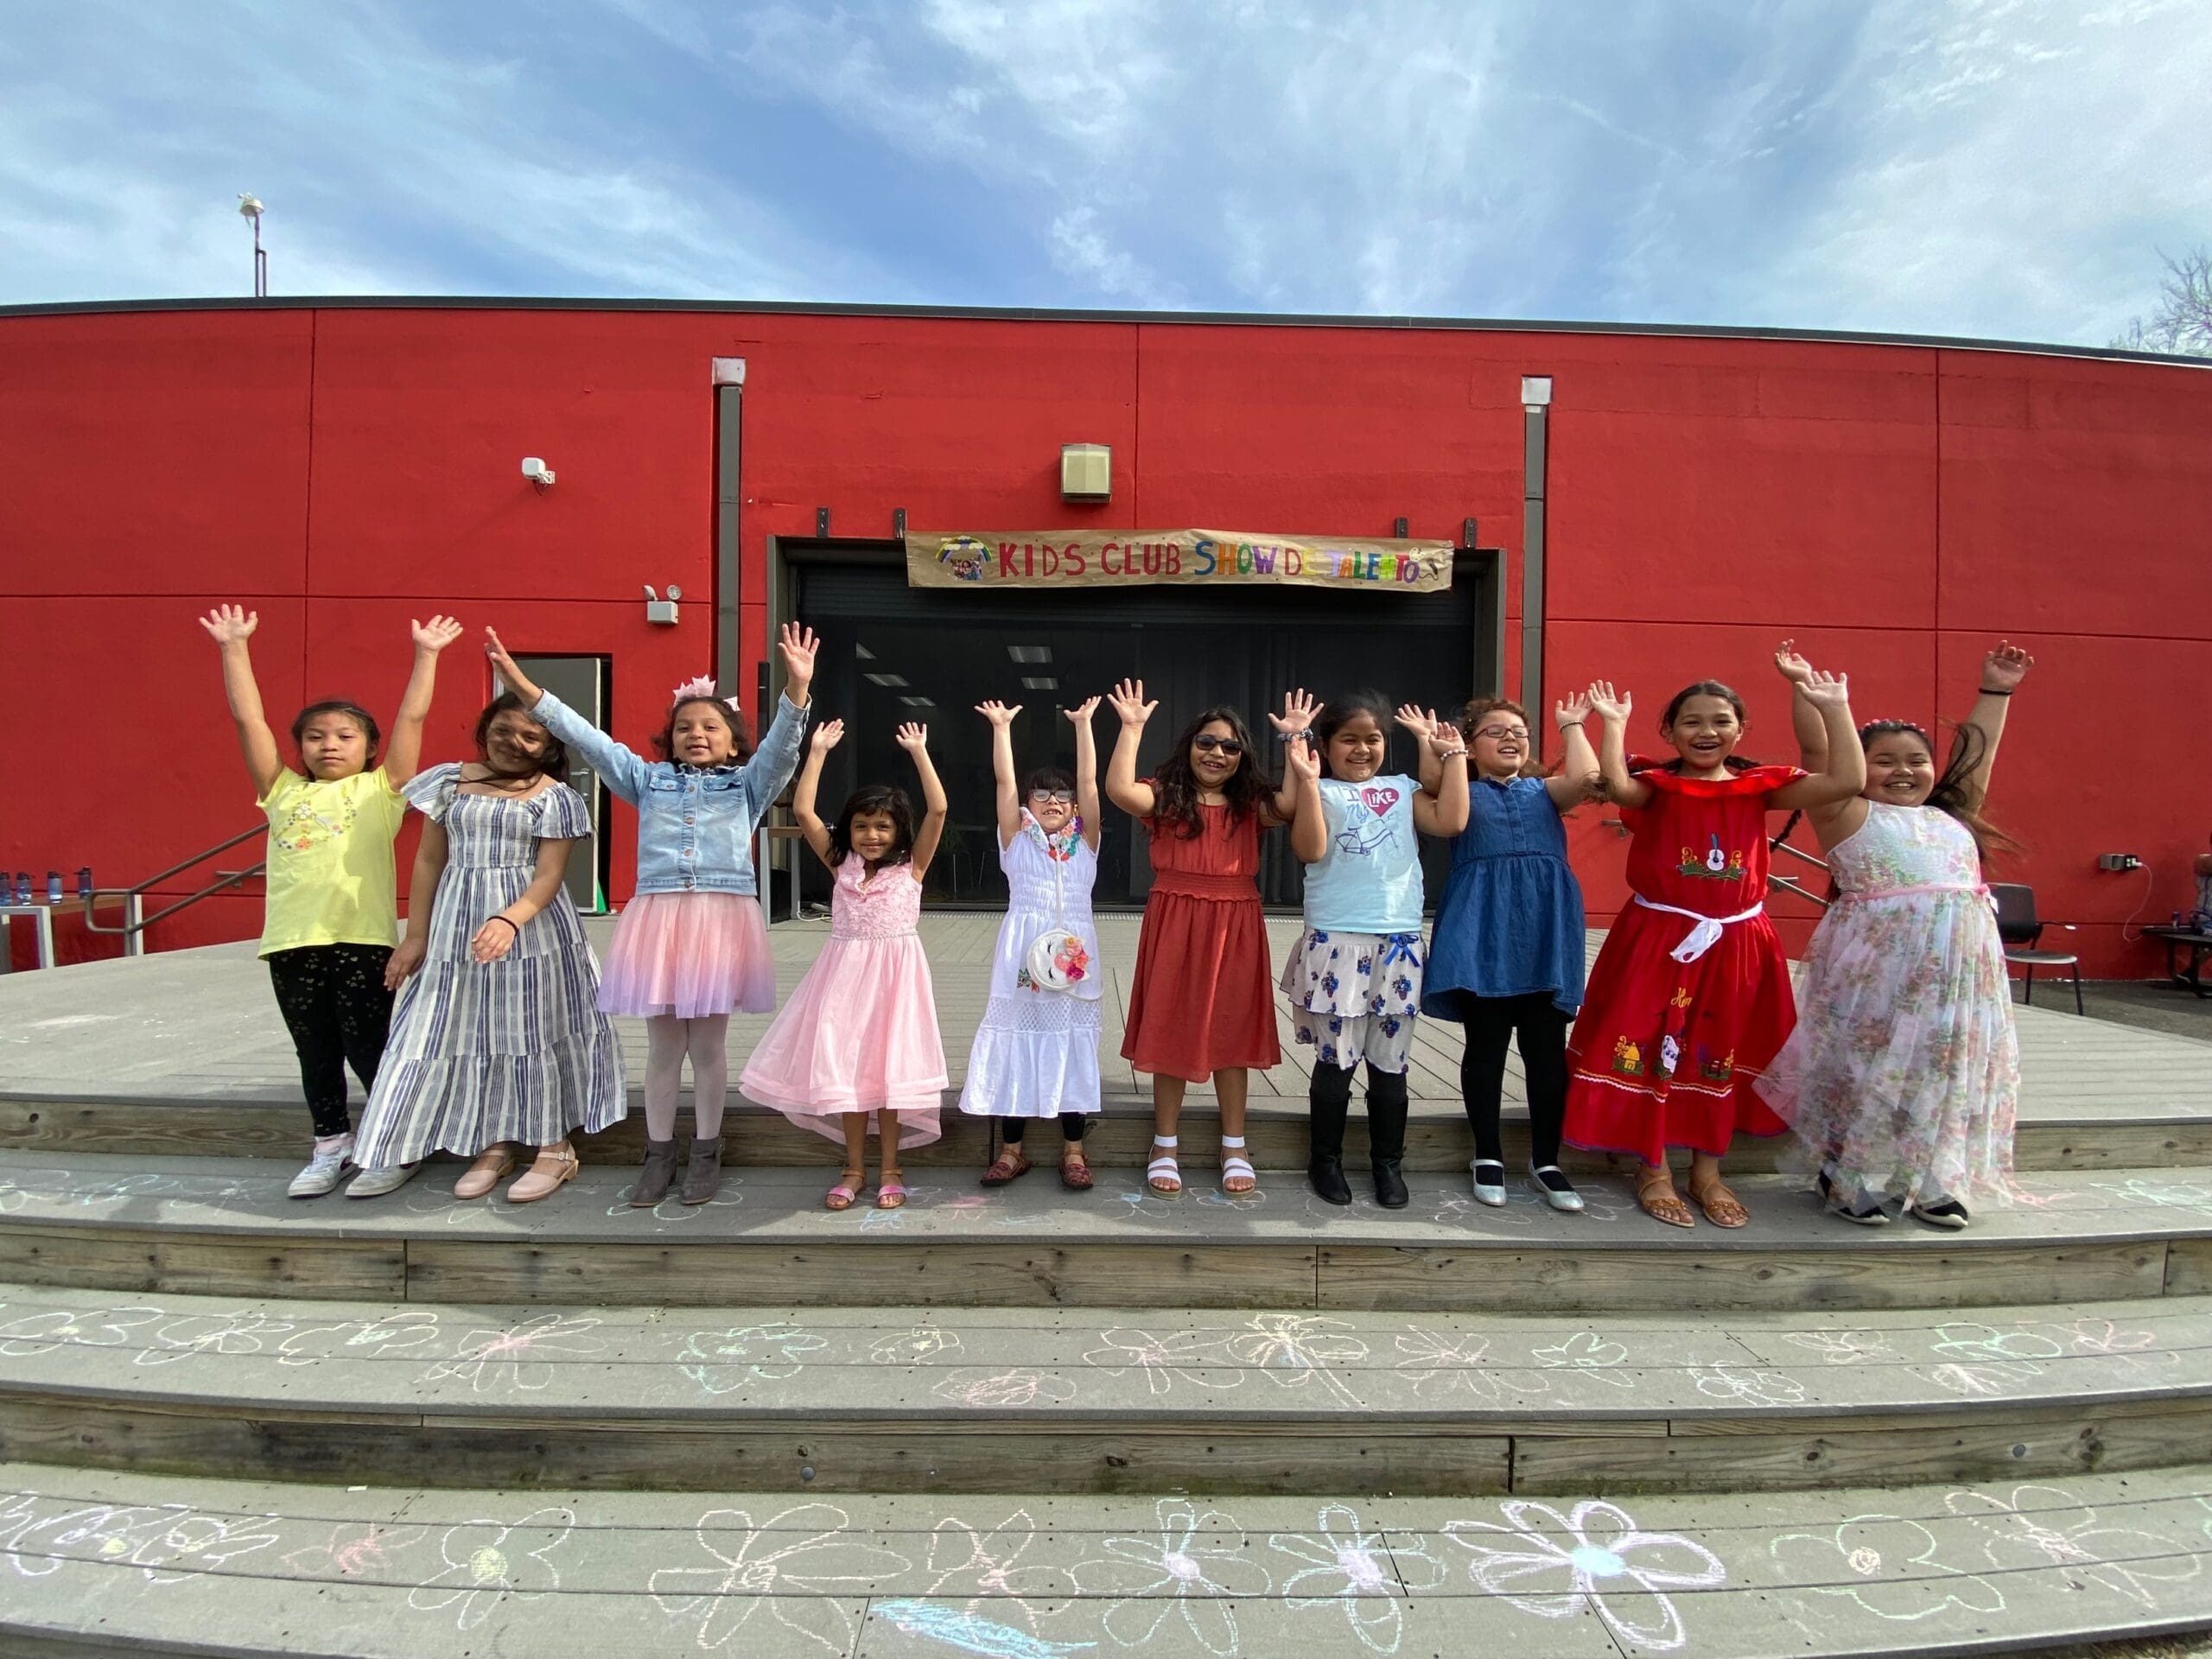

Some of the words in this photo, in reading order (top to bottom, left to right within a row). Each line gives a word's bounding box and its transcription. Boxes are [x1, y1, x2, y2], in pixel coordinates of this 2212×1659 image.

[999, 543, 1085, 578] KIDS
[1101, 543, 1180, 576] CLUB
[1194, 541, 1277, 575] SHOW
[1285, 547, 1319, 575] DE
[1325, 550, 1420, 583] TALENTO
[1343, 788, 1359, 801] I
